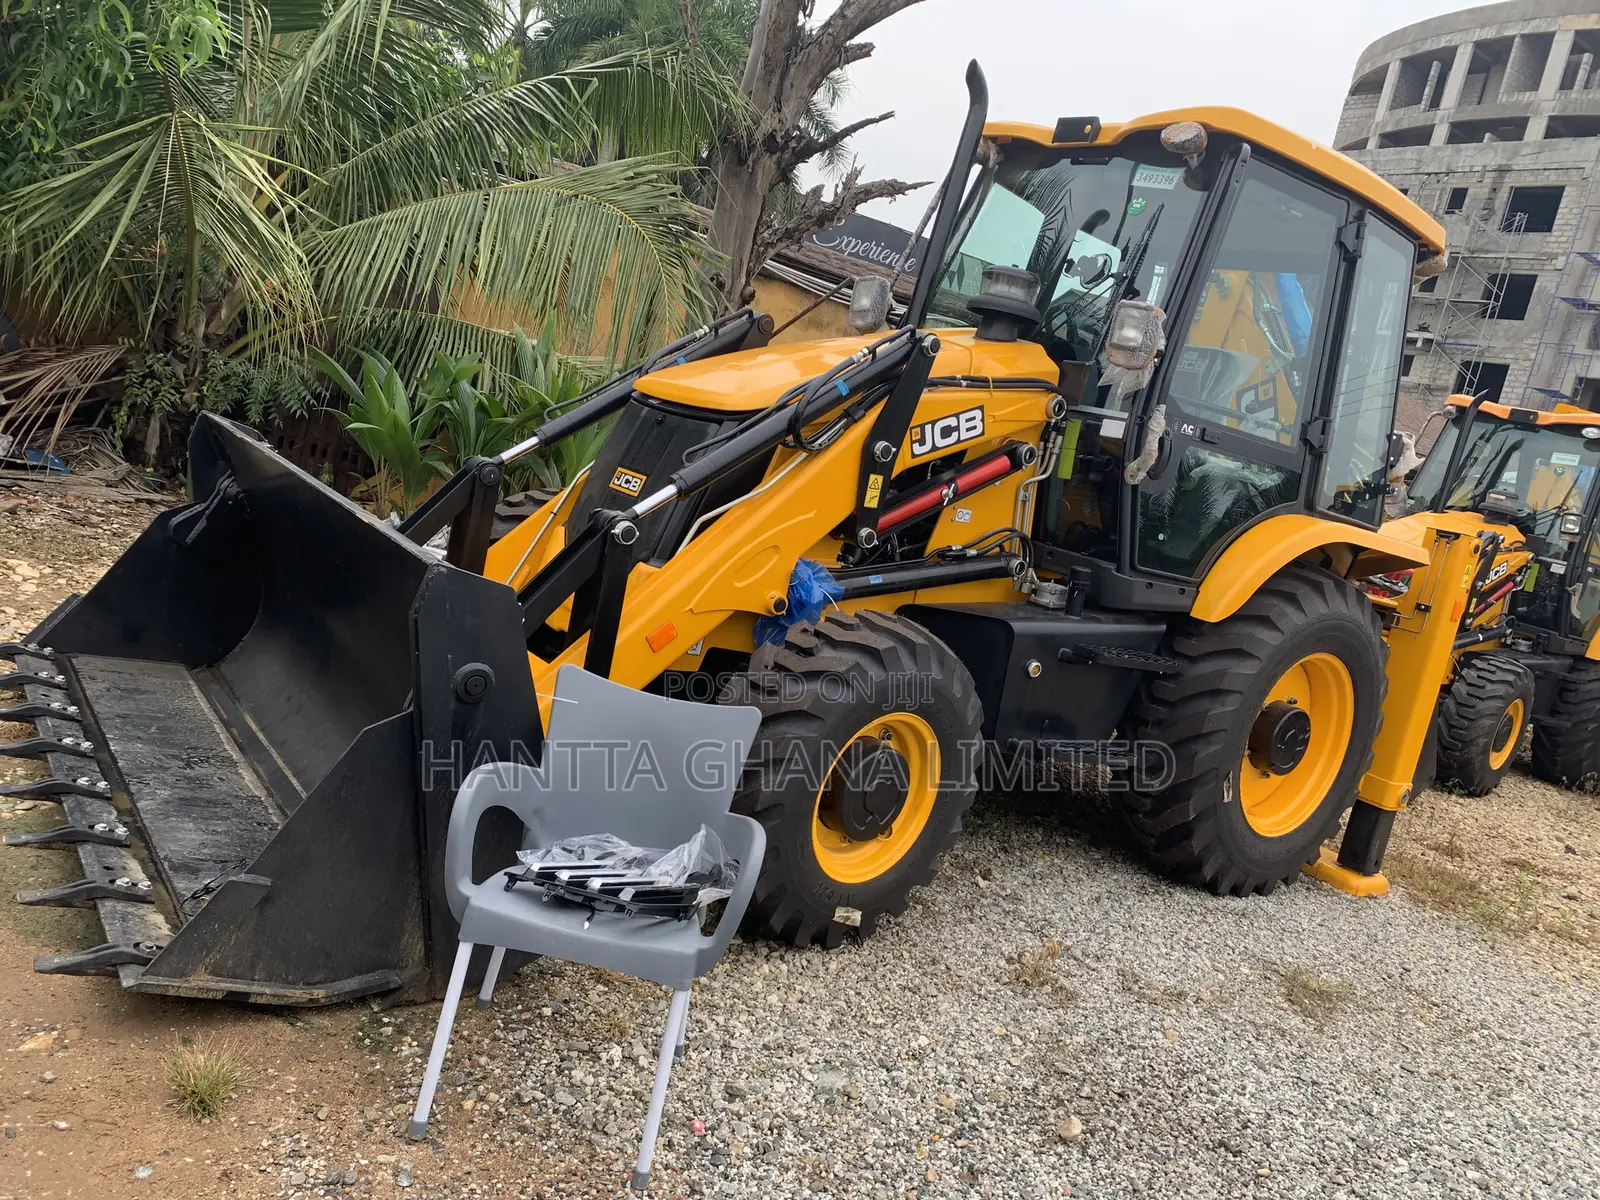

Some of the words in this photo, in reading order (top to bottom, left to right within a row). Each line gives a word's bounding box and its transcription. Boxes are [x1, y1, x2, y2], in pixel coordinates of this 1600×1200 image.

[812, 218, 916, 272] Experiene
[912, 409, 984, 455] JCB
[1180, 423, 1195, 436] AC
[613, 473, 641, 491] JCB
[1484, 561, 1508, 585] JCB
